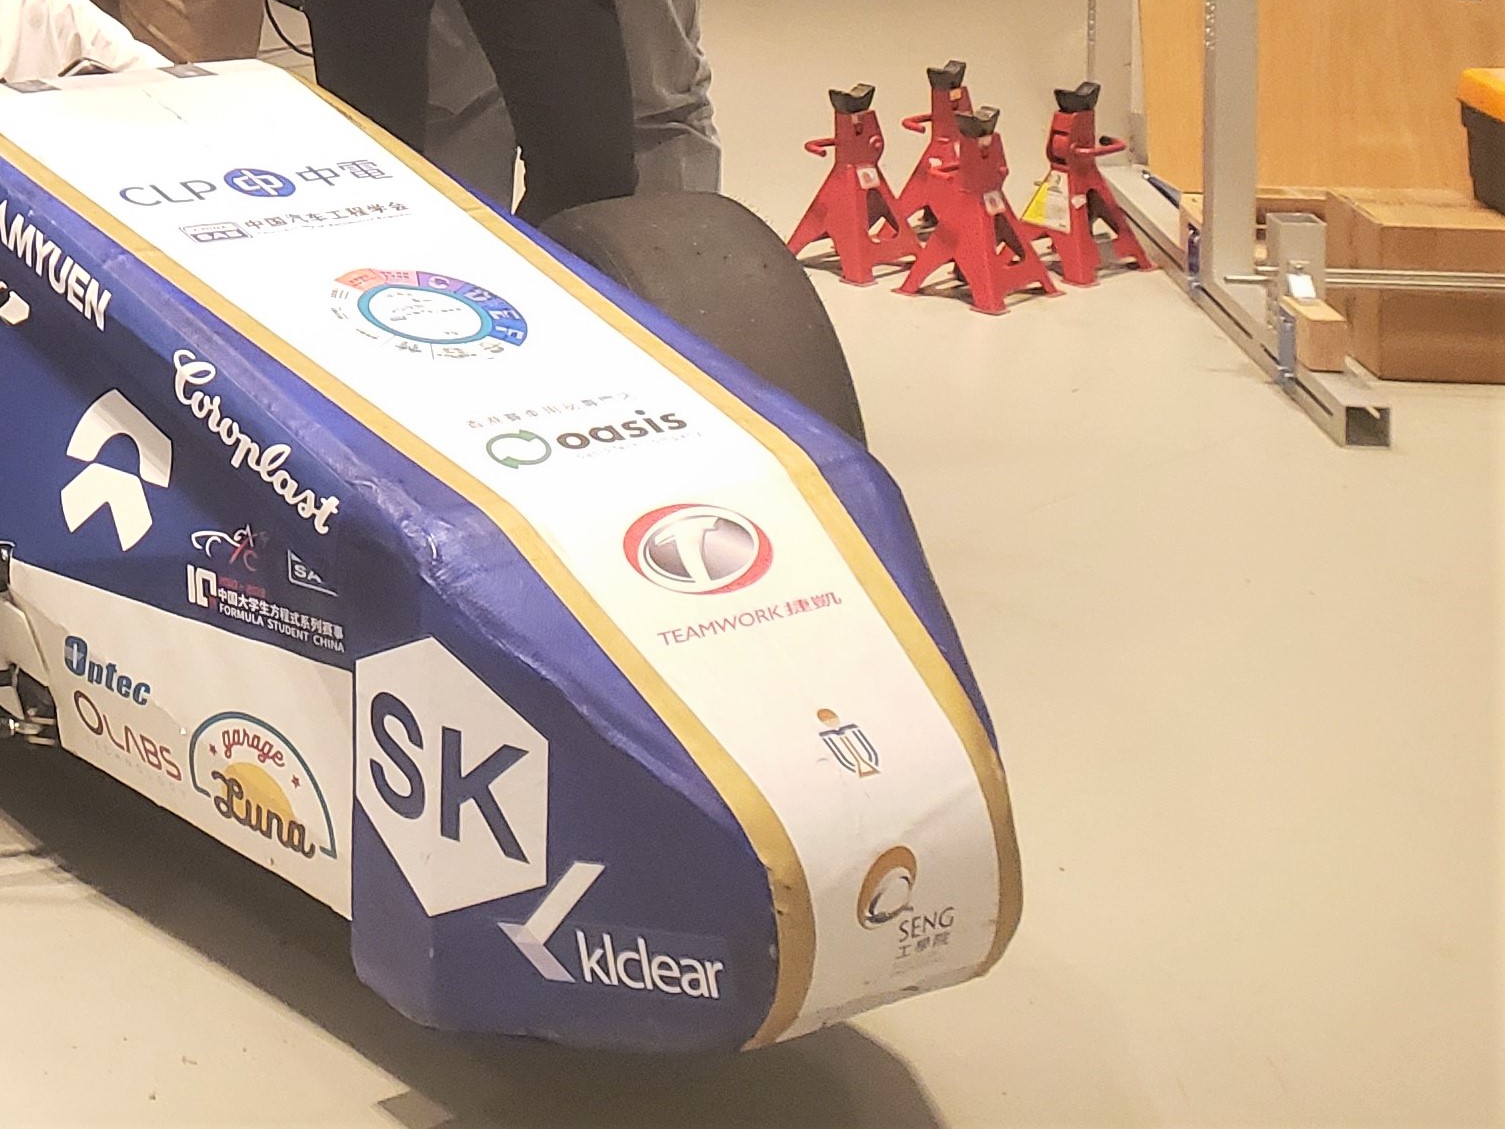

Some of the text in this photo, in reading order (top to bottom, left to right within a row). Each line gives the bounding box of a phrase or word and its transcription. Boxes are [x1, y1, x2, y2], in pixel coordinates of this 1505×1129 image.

[119, 159, 394, 207] CLP 中電
[245, 201, 410, 230] 中国汽车工程学会
[173, 348, 340, 536] Coroplast
[556, 409, 688, 450] oasis
[219, 603, 345, 653] FORMULA STUDENT CHINA
[657, 604, 784, 646] TEAMWORK
[221, 728, 286, 768] garage
[369, 691, 531, 865] SK
[211, 770, 316, 858] Luna
[898, 906, 954, 943] SENG
[575, 928, 725, 1000] klclear
